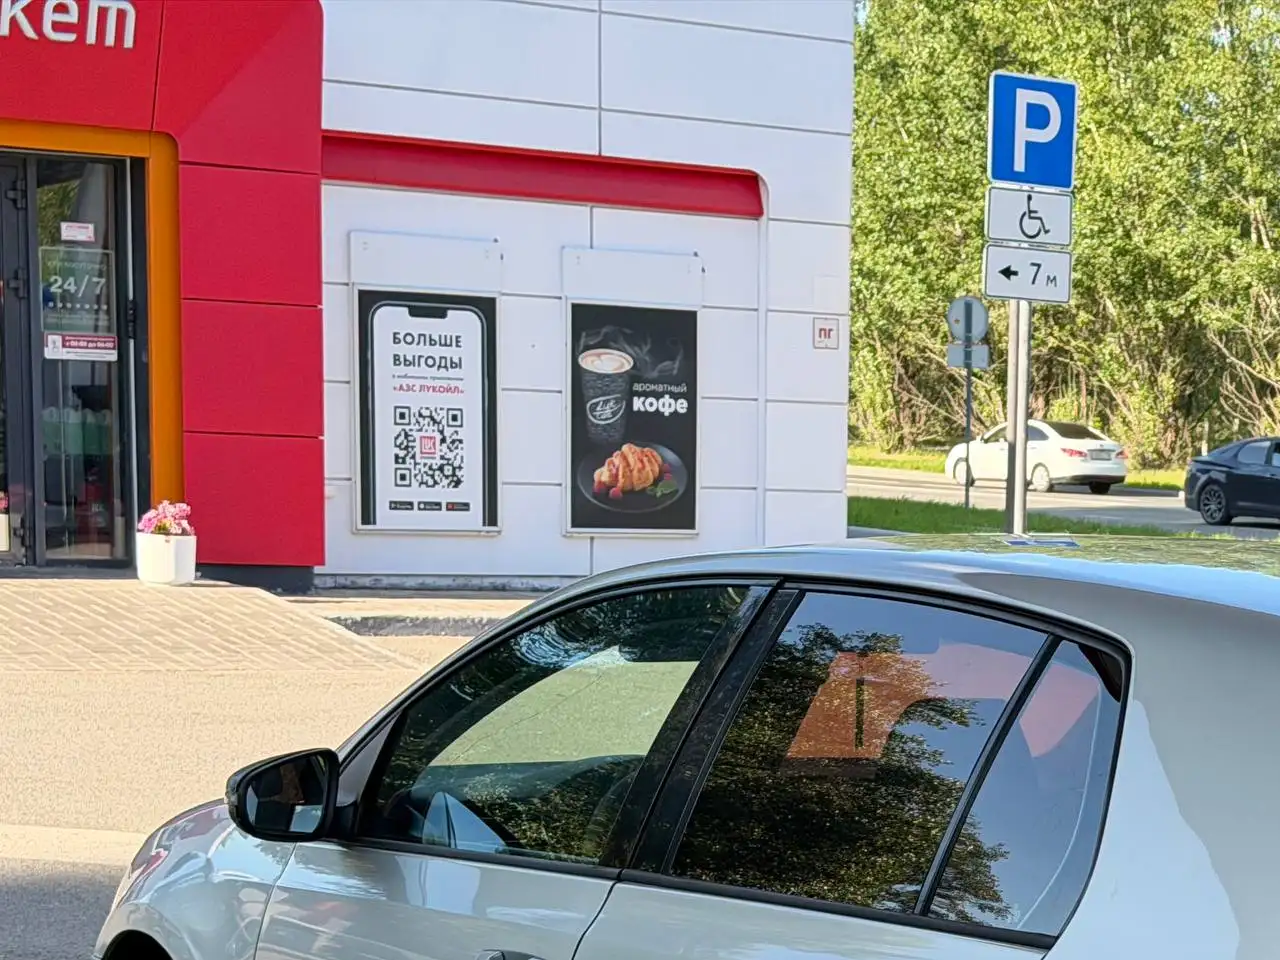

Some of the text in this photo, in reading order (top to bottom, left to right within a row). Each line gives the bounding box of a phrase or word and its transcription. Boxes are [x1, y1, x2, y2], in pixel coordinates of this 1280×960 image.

[1013, 88, 1062, 172] P
[1029, 262, 1042, 285] 7
[50, 275, 106, 297] 24/7
[392, 332, 462, 348] БОЛЬШЕ
[393, 354, 462, 371] ВЫГОДЫ
[633, 383, 688, 393] ароматный
[633, 394, 689, 416] кофе
